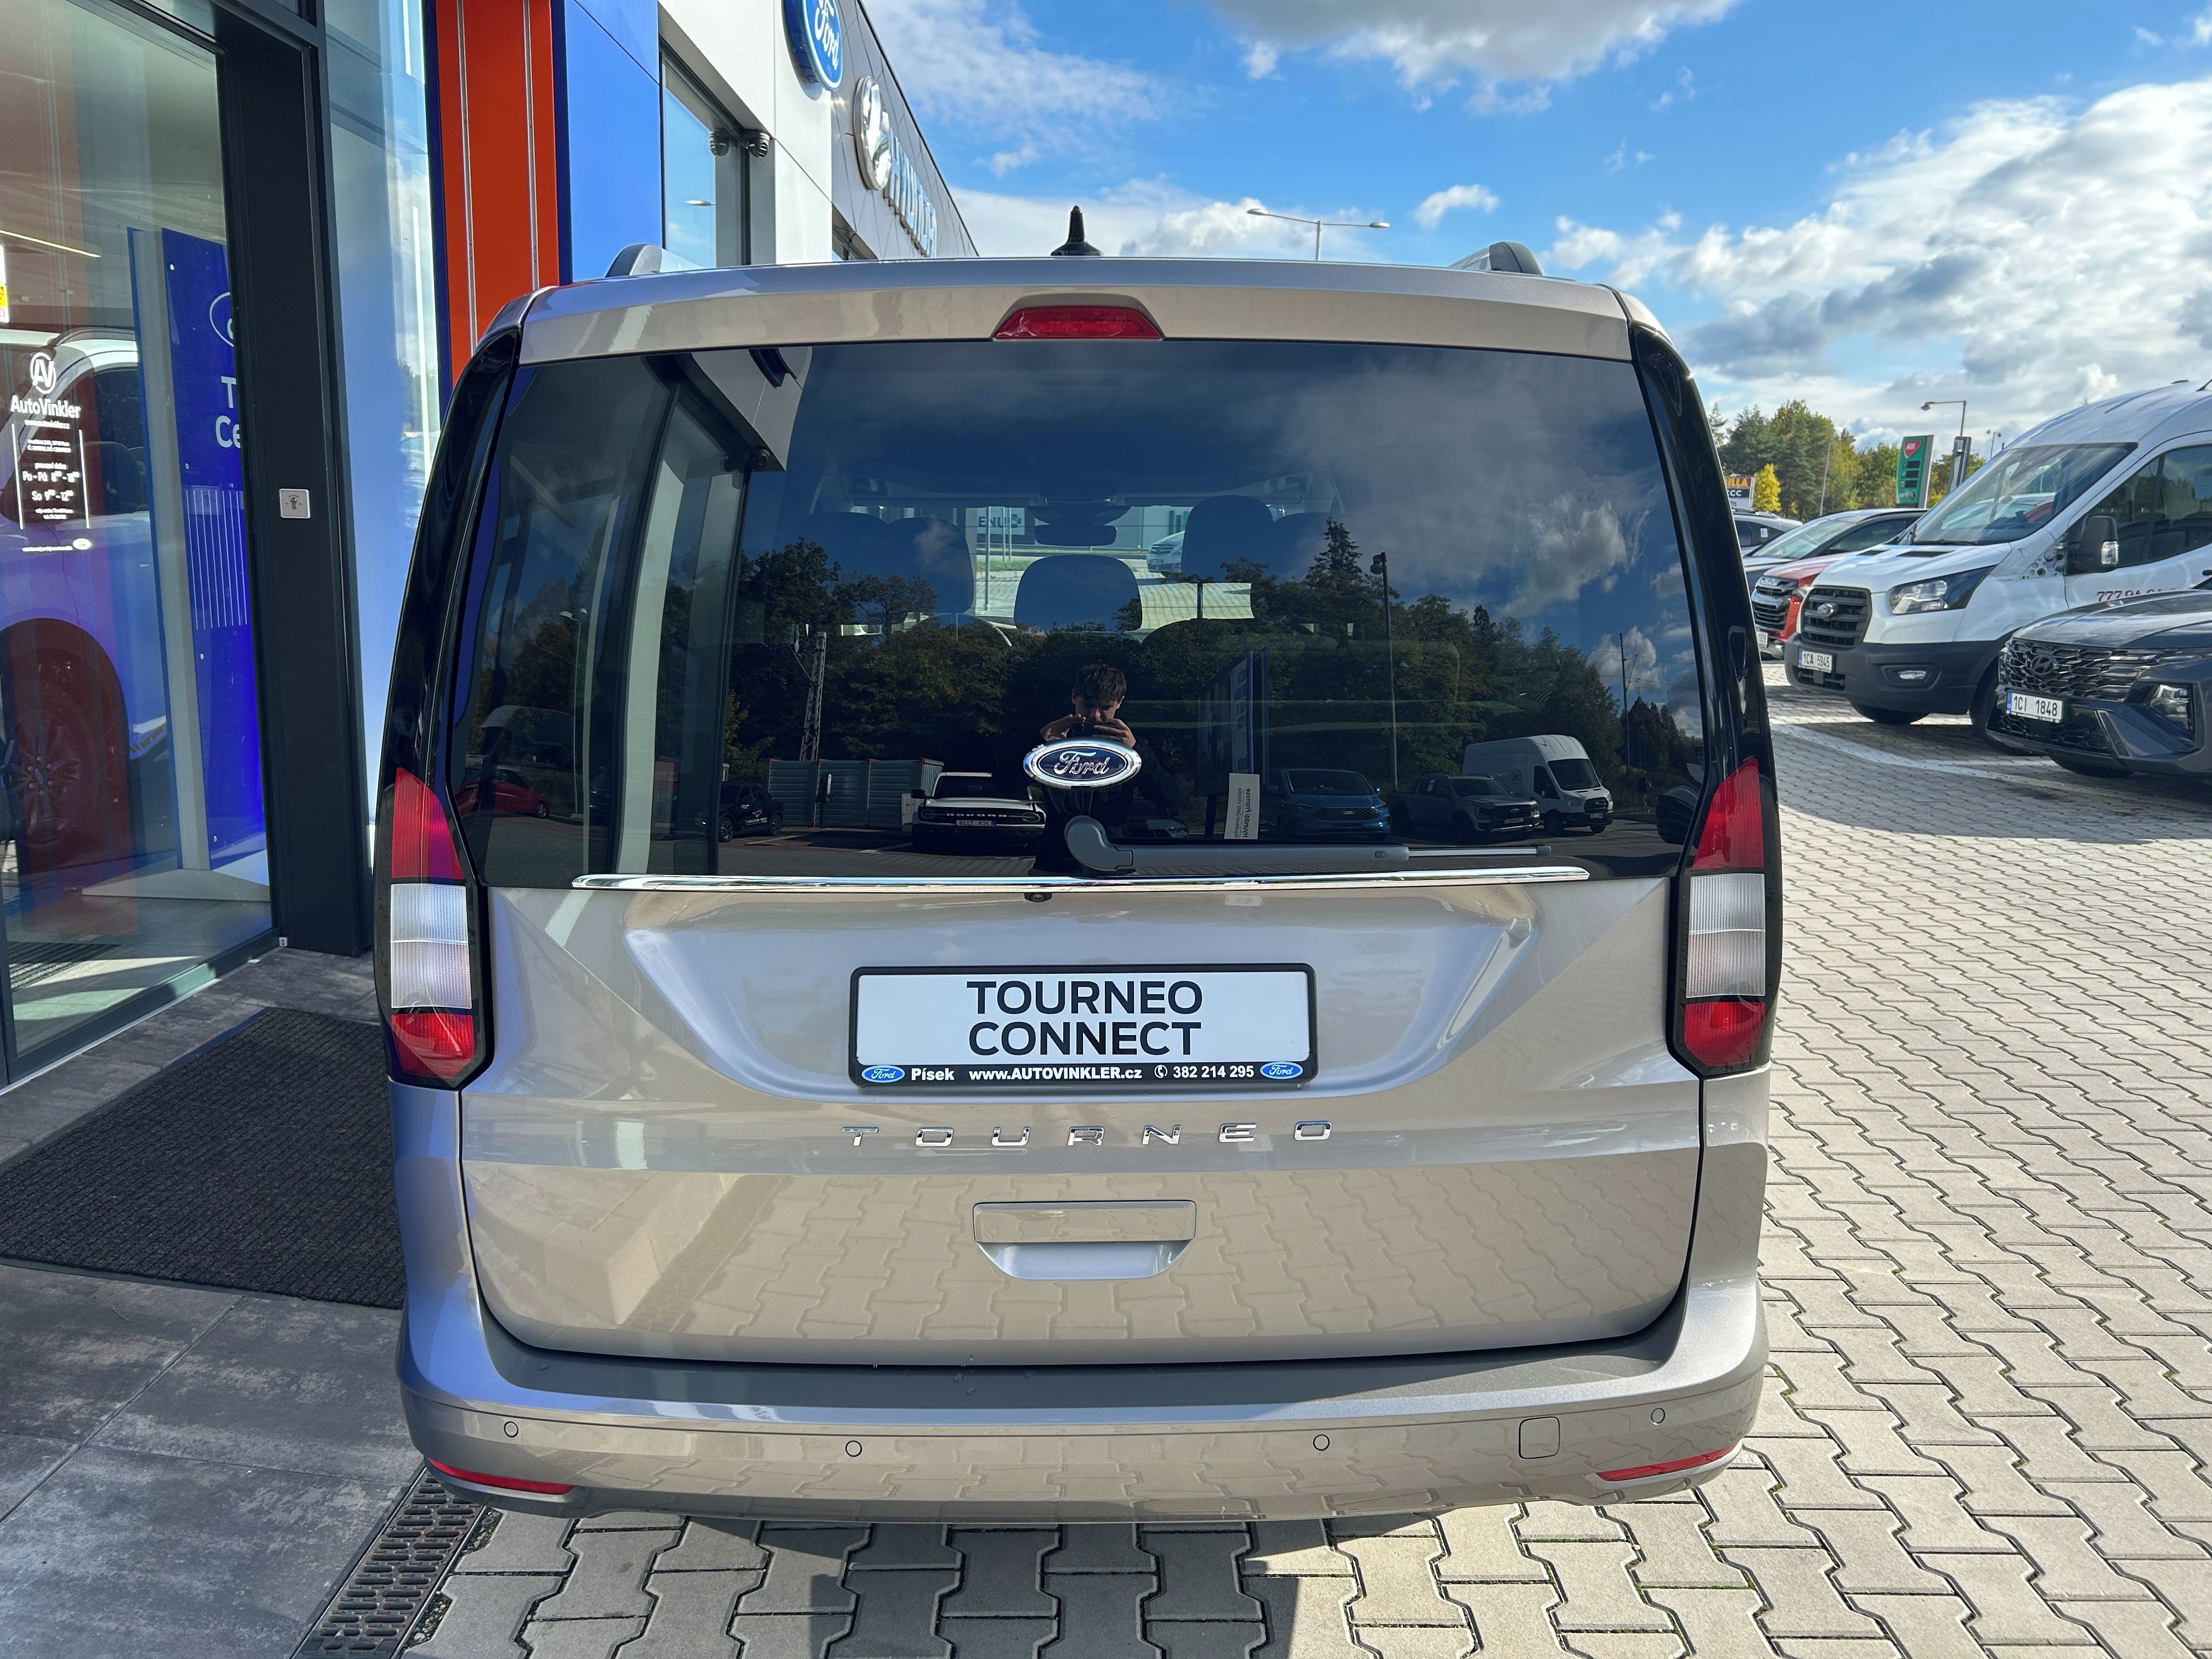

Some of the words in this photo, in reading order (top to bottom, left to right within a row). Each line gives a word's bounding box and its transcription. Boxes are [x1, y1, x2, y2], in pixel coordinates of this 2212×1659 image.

[815, 0, 840, 71] Ford
[10, 394, 81, 419] AutoVinkler
[1724, 478, 1748, 487] ILLA
[1803, 652, 1814, 665] 1CA
[1817, 655, 1830, 669] 5945
[2014, 695, 2027, 712] 1CI
[2035, 699, 2057, 717] 1848
[1053, 751, 1111, 775] Ford
[967, 980, 1203, 1014] TOURNEO
[969, 1022, 1201, 1056] CONNECT
[871, 1068, 896, 1079] Ford
[911, 1068, 955, 1081] Písek
[969, 1066, 1142, 1080] www.AUTOVINKLER.cz
[1173, 1066, 1198, 1078] 382
[1201, 1065, 1226, 1078] 214
[1229, 1065, 1254, 1077] 295
[1269, 1064, 1294, 1076] Ford
[842, 1120, 1331, 1147] TOURNEO
